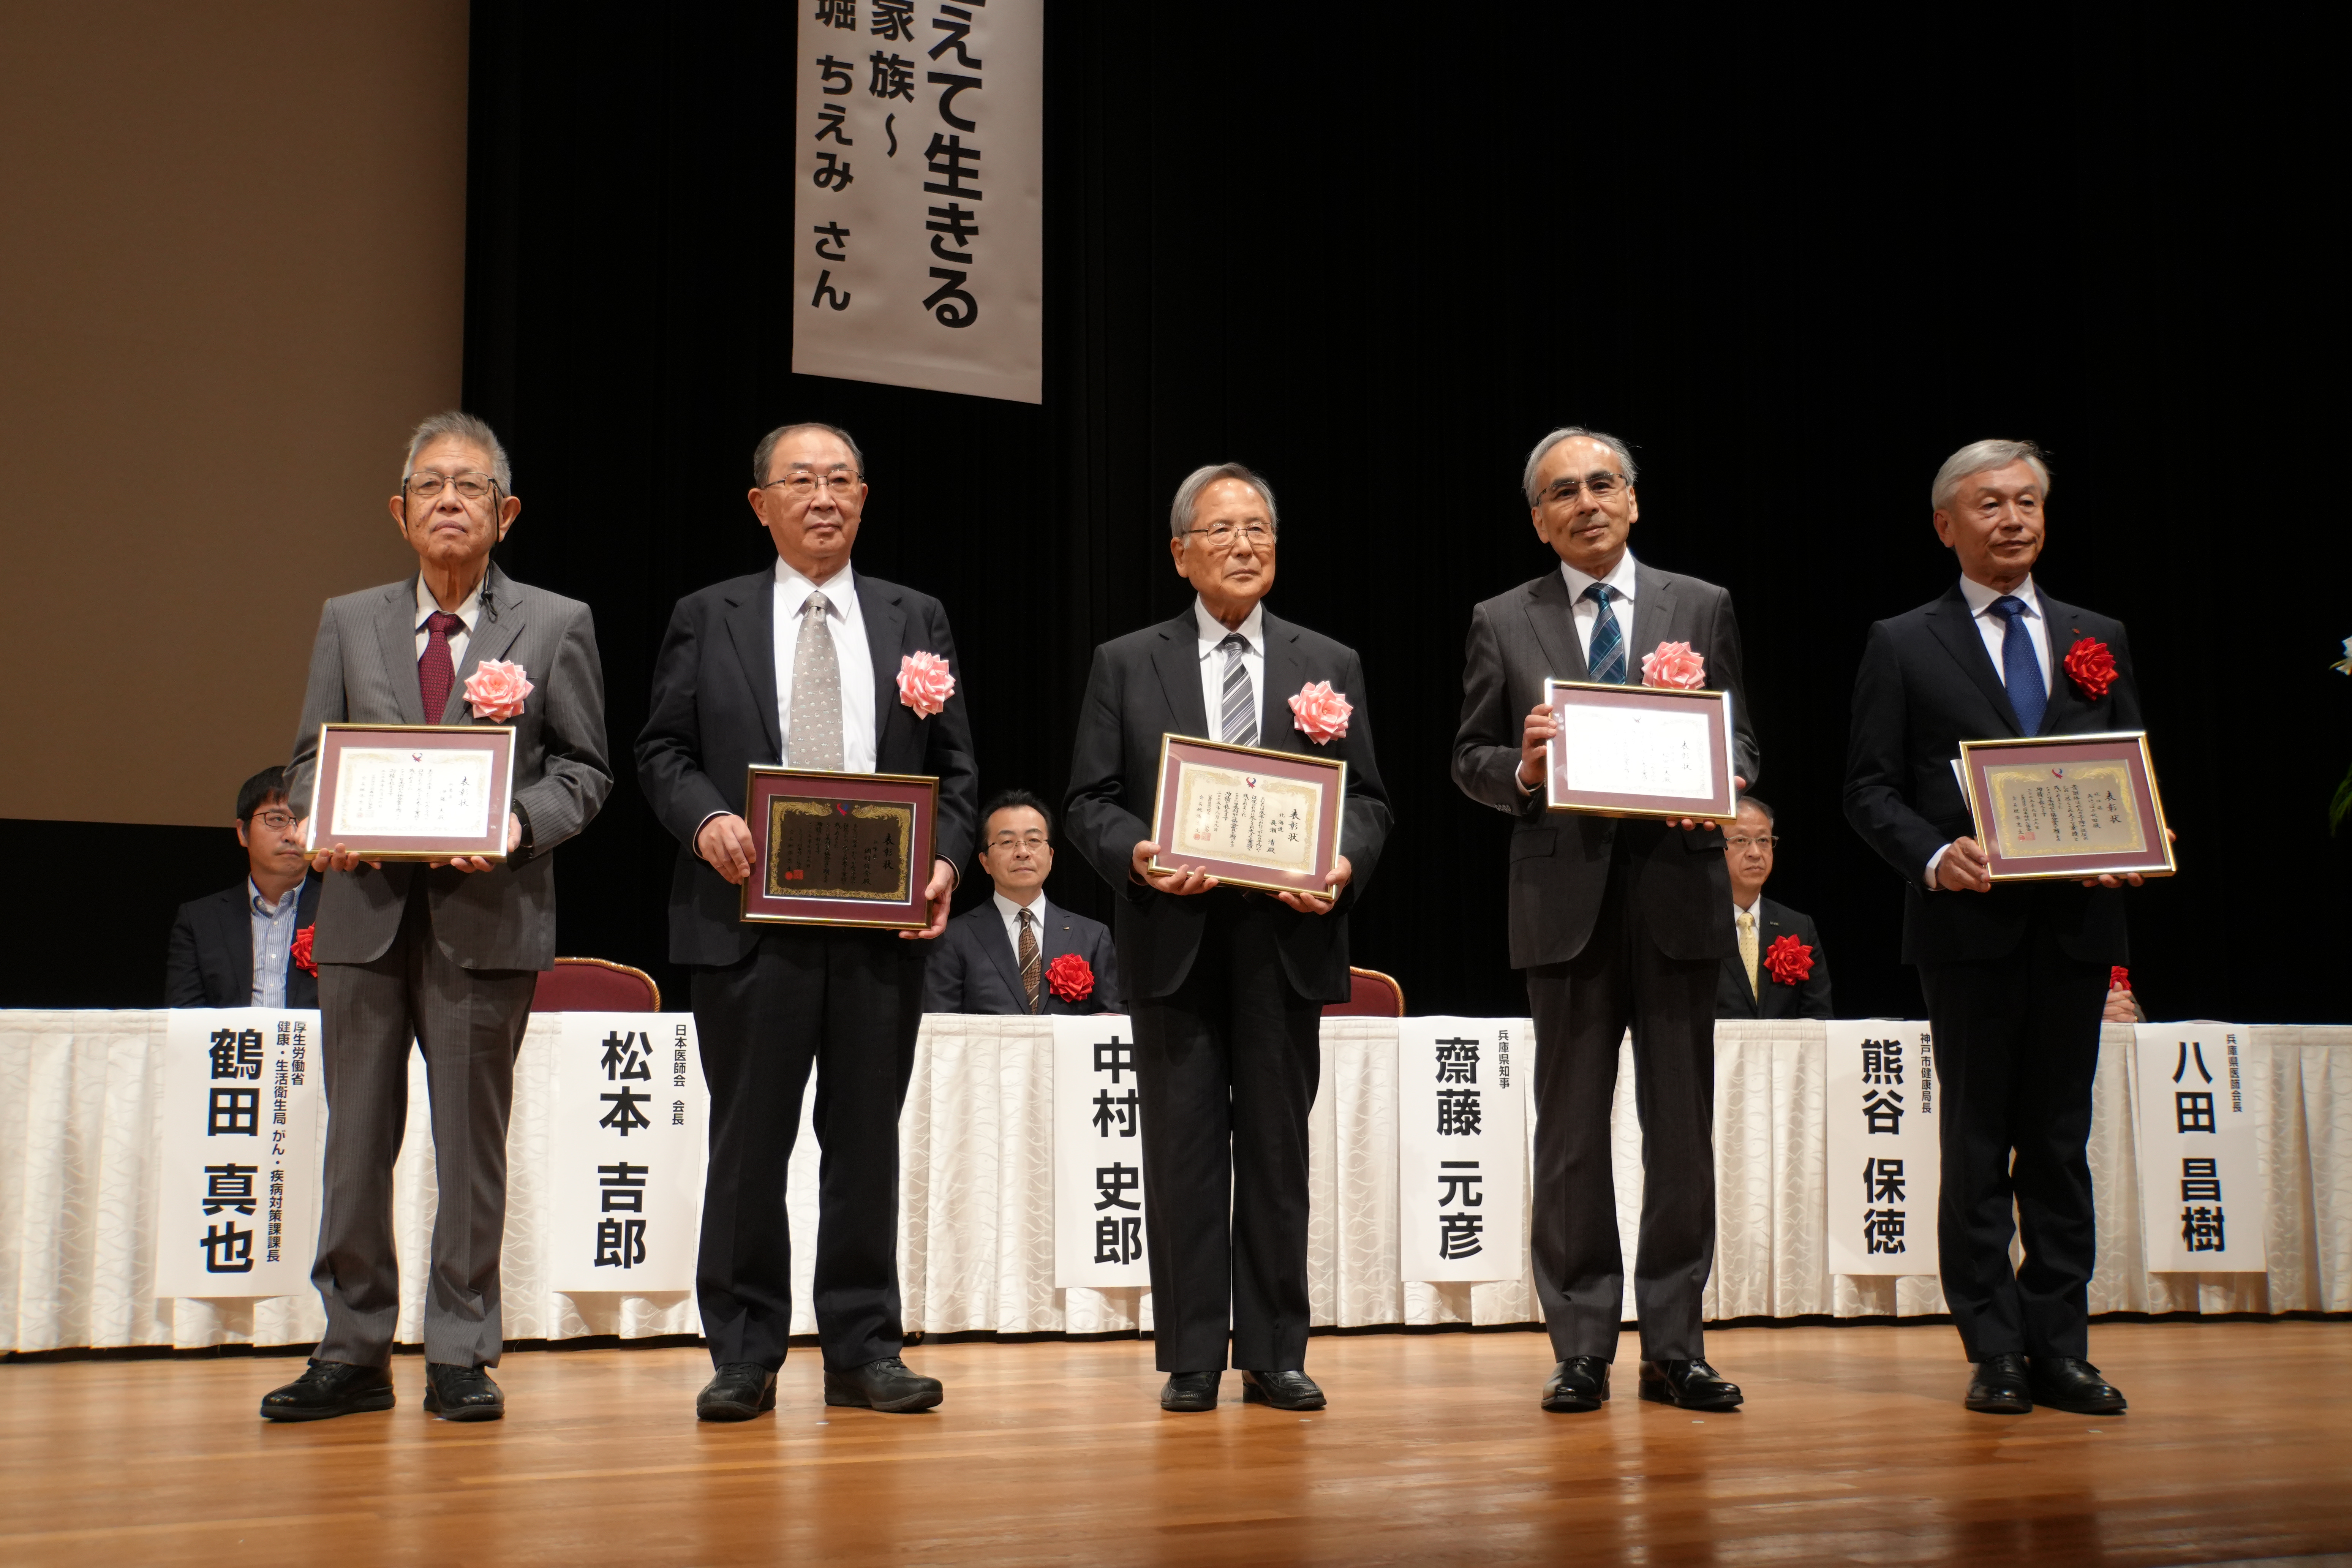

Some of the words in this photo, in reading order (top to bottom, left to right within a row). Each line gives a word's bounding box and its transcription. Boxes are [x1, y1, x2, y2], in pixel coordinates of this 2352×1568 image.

[813, 55, 854, 193] ちえみ
[922, 0, 986, 328] えて生きる
[811, 221, 851, 311] さん
[458, 776, 471, 807] 表彰状
[1680, 740, 1692, 770] 表彰状
[883, 833, 895, 870] 表彰状
[1287, 809, 1301, 842] 表彰状
[2105, 790, 2122, 824] 表彰状
[207, 1027, 264, 1137] 鶴田
[273, 1021, 291, 1125] 健康・生活衛生局
[291, 1021, 307, 1086] 厚生労働省
[598, 1030, 654, 1136] 松本
[673, 1024, 687, 1087] 日本医師会
[1092, 1035, 1140, 1137] 中村
[1498, 1029, 1510, 1089] 兵庫県知事
[1861, 1038, 1905, 1135] 熊谷
[1920, 1033, 1932, 1113] 神戸市健康局長
[2172, 1042, 2216, 1134] 八田
[2226, 1034, 2243, 1113] 兵庫県医師会長
[672, 1100, 685, 1125] 会長
[199, 1162, 259, 1274] 真也
[266, 1129, 286, 1263] がん・疾病対策課課長
[594, 1162, 649, 1269] 吉郎
[1093, 1162, 1142, 1265] 史郎
[1437, 1161, 1483, 1260] 元彦
[1863, 1157, 1906, 1255] 保徳
[2180, 1158, 2225, 1252] 昌樹
